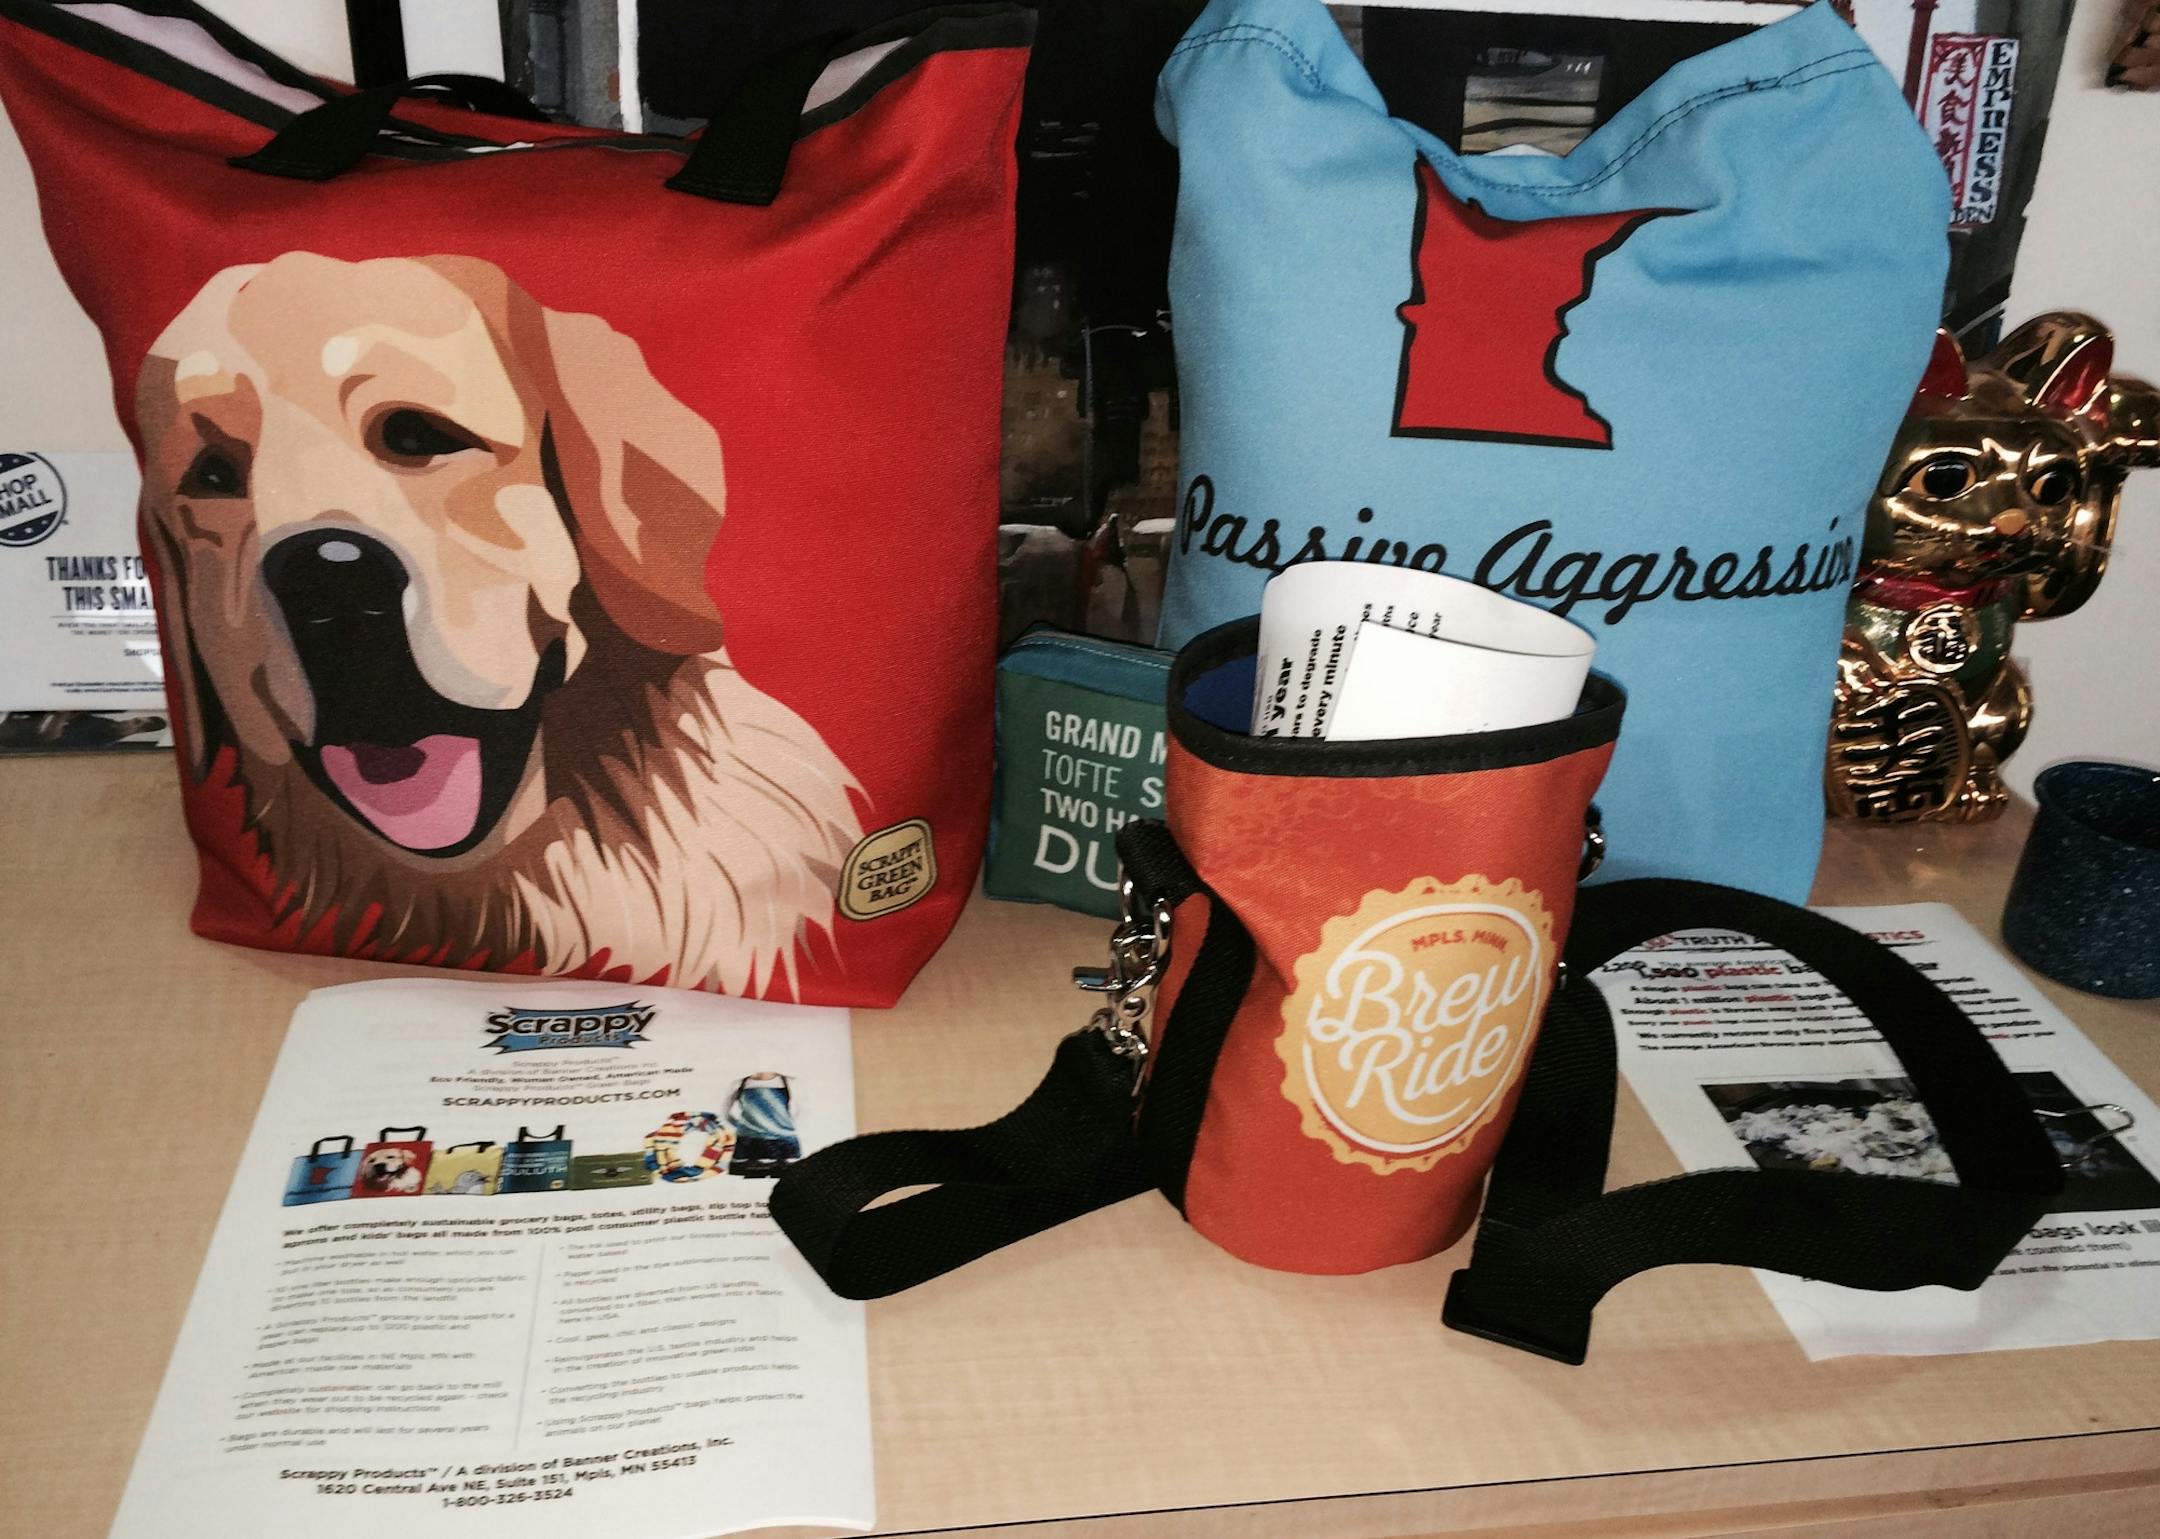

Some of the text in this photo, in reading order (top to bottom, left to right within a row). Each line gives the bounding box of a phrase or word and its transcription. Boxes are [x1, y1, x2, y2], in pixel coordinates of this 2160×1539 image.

[1180, 474, 1446, 570] Passive
[45, 556, 118, 581] THANKS
[62, 586, 105, 611] THIS
[1301, 629, 1322, 690] degrade
[1271, 657, 1294, 721] year
[1312, 624, 1347, 738] every minute
[1045, 710, 1142, 759] GRAND
[1042, 748, 1123, 799] TOFTE
[1040, 787, 1099, 828] TWO
[858, 857, 923, 890] GREEN
[1673, 936, 1748, 946] TRUTH
[1681, 983, 1723, 993] plastic
[1704, 964, 1784, 979] plastic
[1308, 949, 1540, 1044] Brew
[1744, 993, 1794, 1004] plastic
[484, 1010, 657, 1036] Scrappy
[1338, 1011, 1512, 1125] Ride
[442, 1087, 682, 1108] SCRAPPYPRODUCTS.COM
[662, 1213, 705, 1226] plastic
[279, 1467, 350, 1481] Scrappy
[473, 1459, 538, 1476] division
[540, 1457, 559, 1471] of
[561, 1452, 620, 1470] Banner
[622, 1440, 703, 1462] Creations,
[317, 1482, 359, 1496] 1620
[361, 1482, 423, 1496] Central
[426, 1481, 458, 1495] Ave
[495, 1475, 537, 1490] Suite
[620, 1464, 646, 1477] MN
[650, 1454, 698, 1473] 55413
[441, 1486, 575, 1509] 1-800-326-3524
